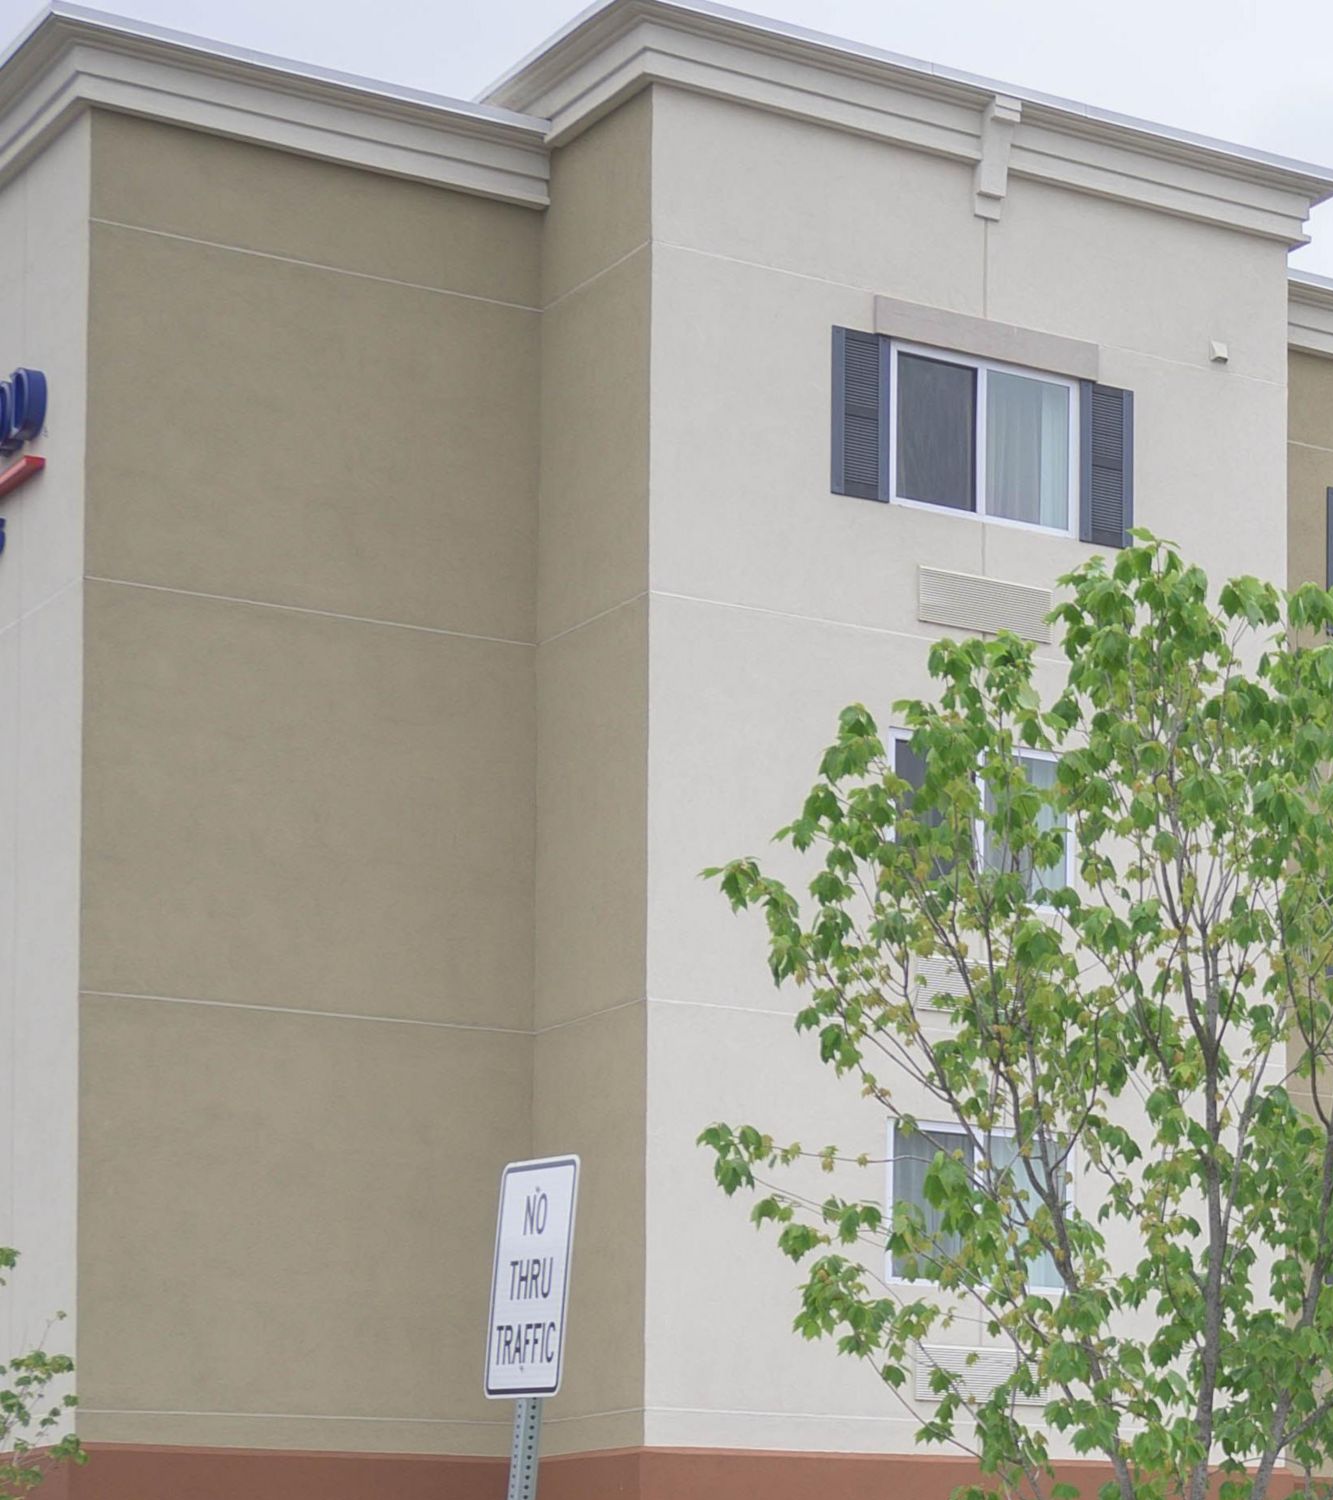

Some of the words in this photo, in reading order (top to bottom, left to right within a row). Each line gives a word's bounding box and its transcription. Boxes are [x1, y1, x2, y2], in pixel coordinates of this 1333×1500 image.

[522, 1193, 548, 1236] NO
[509, 1257, 554, 1300] THRU
[496, 1321, 556, 1365] TRAFFIC
